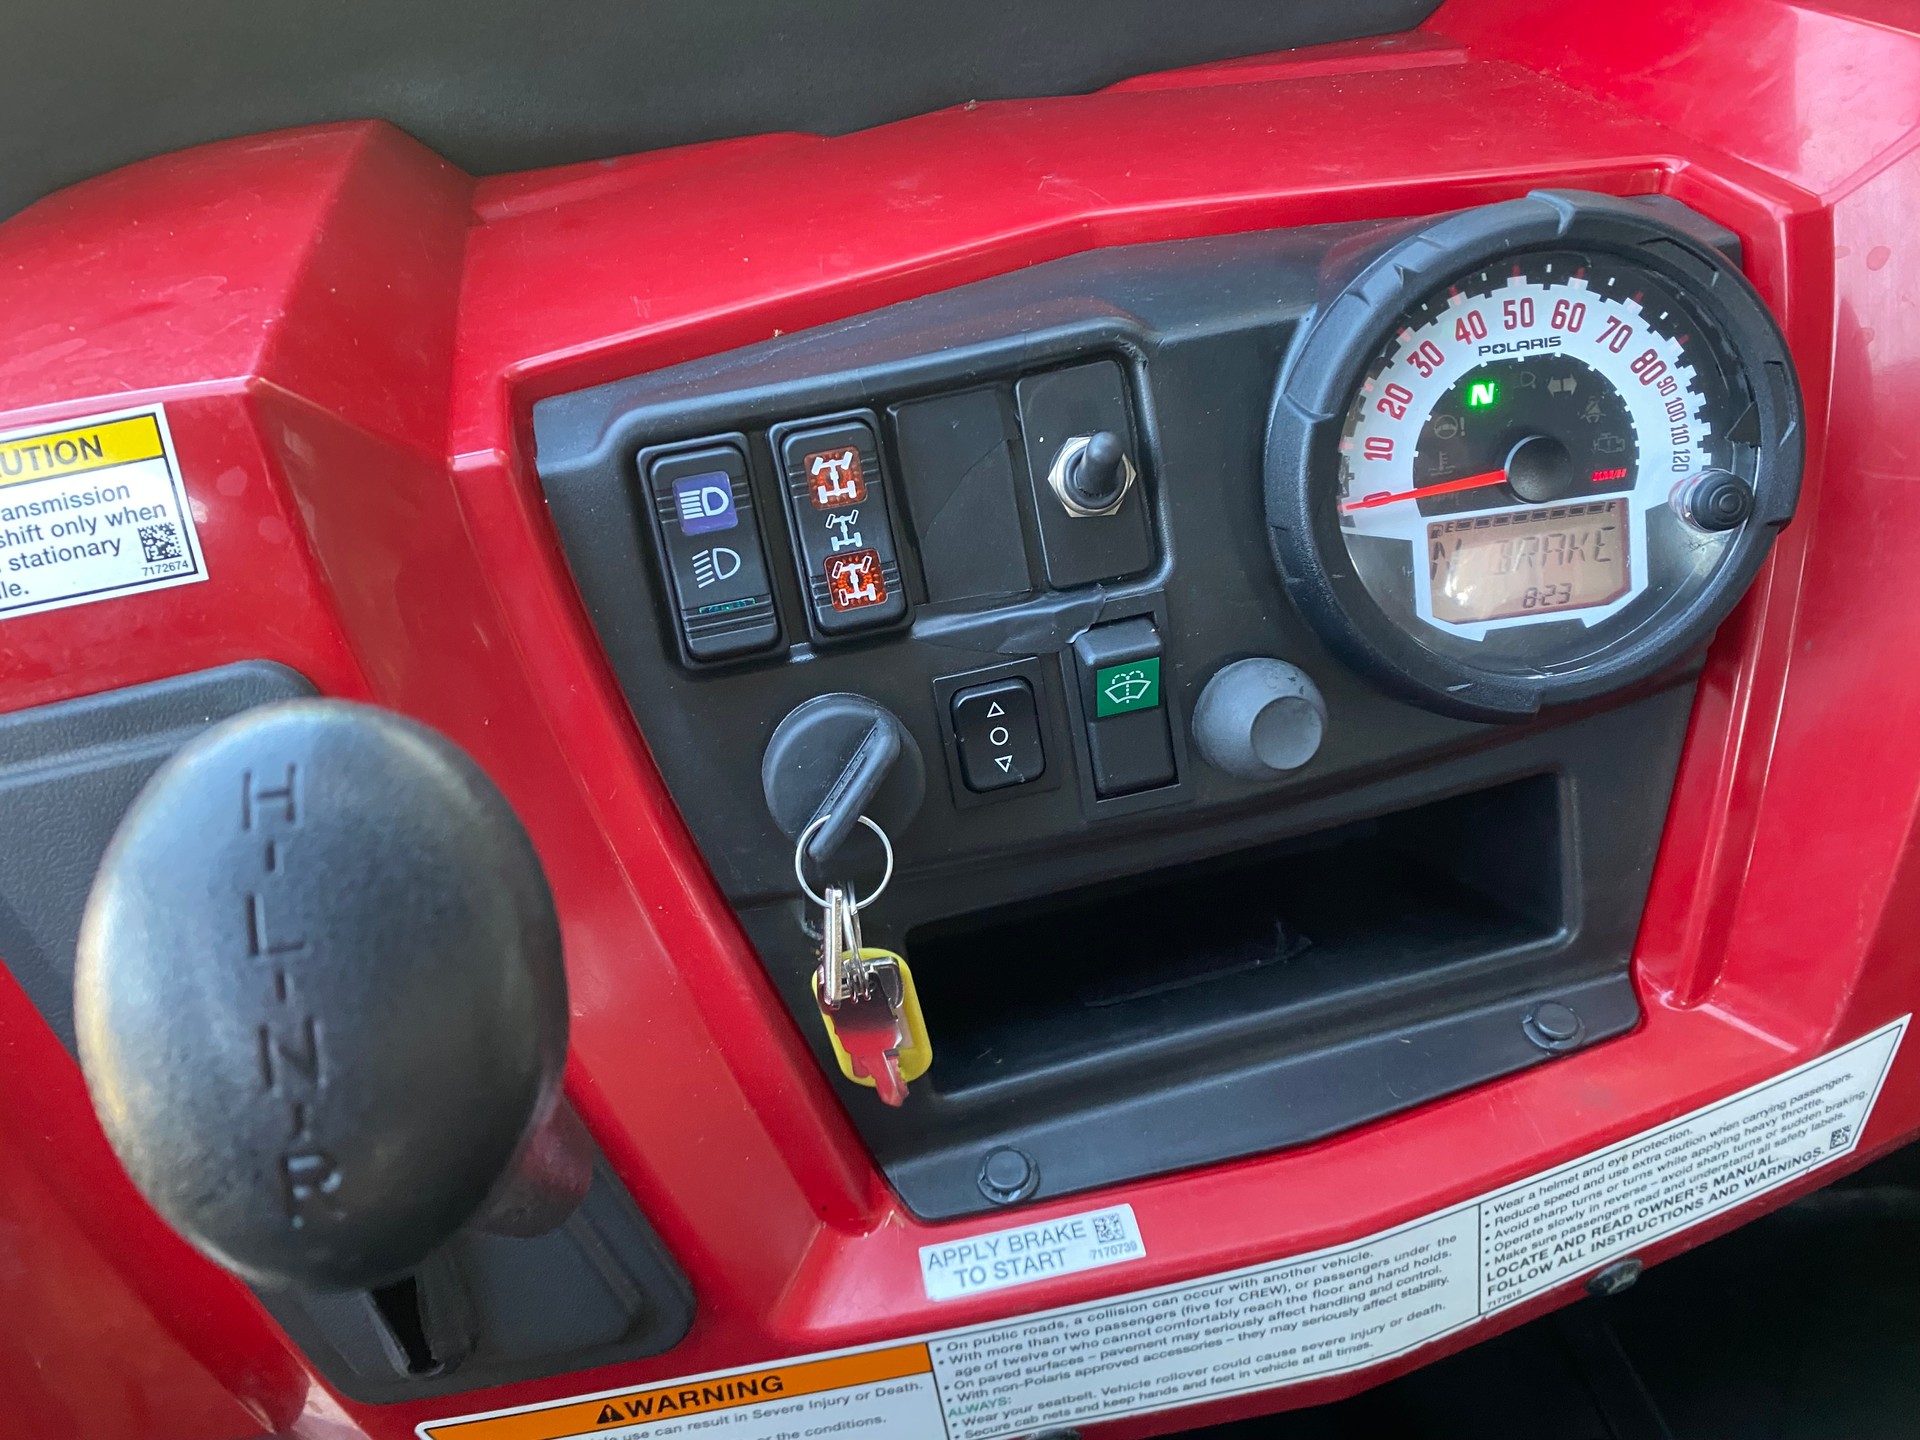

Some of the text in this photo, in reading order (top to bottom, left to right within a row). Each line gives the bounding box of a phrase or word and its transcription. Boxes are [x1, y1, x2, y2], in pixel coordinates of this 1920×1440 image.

[1455, 310, 1488, 345] 40
[1503, 297, 1534, 330] 50
[1551, 299, 1586, 333] 60
[1478, 336, 1561, 357] POLARIS
[1595, 315, 1633, 354] 70
[1406, 340, 1445, 378] 30
[1630, 349, 1667, 386] 80
[1376, 382, 1414, 421] 20
[1471, 383, 1495, 406] N
[1656, 375, 1678, 397] 90
[1665, 397, 1687, 423] 100
[1363, 436, 1394, 461] 10
[1670, 424, 1690, 445] 110
[0, 434, 103, 477] UTION
[1672, 449, 1691, 472] 120
[51, 515, 97, 537] only
[105, 504, 167, 527] when
[8, 538, 121, 571] stationary
[141, 559, 189, 576] 7172674
[1522, 582, 1572, 608] 8:23
[1493, 1153, 1628, 1213] Wear helmet and eye
[1494, 1101, 1787, 1227] Reduce speed and use extra caution when carrying
[1494, 1117, 1778, 1240] Avoid sharp turns or turns while applying heavy
[1494, 1109, 1822, 1252] Operate slowly in reverse avoid sharp turns sudden
[1494, 1128, 1808, 1265] Make sure passengers read and understand all safety
[1487, 1156, 1780, 1283] LOCATE AND READ OWNER'S MANUAL.
[1488, 1147, 1825, 1297] FOLLOW ALL INSTRUCTIONS AND WARNINGS.
[928, 1221, 1087, 1271] APPLY BRAKE
[953, 1248, 1066, 1289] TO START
[949, 1235, 1457, 1365] With more than two passengers for passengers under the
[973, 1265, 1318, 1348] public collision can occur with another
[954, 1264, 1409, 1378] age twelve who cannot comfortably reach the floor and hand
[978, 1281, 1393, 1386] paved surfaces pavement may seriously affect handling and
[957, 1294, 1398, 1403] With approved accessories they may seriously affect
[962, 1324, 1386, 1428] Wear your Vehicle rollover could cause severe injury
[964, 1350, 1333, 1439] Secure cab nets and keep hands and feet vehicle all
[624, 1375, 784, 1418] WARNING
[655, 1382, 923, 1436] can result in Severe Injury Death.
[948, 1397, 1012, 1418] ALWAYS:
[804, 1415, 887, 1437] conditions.
